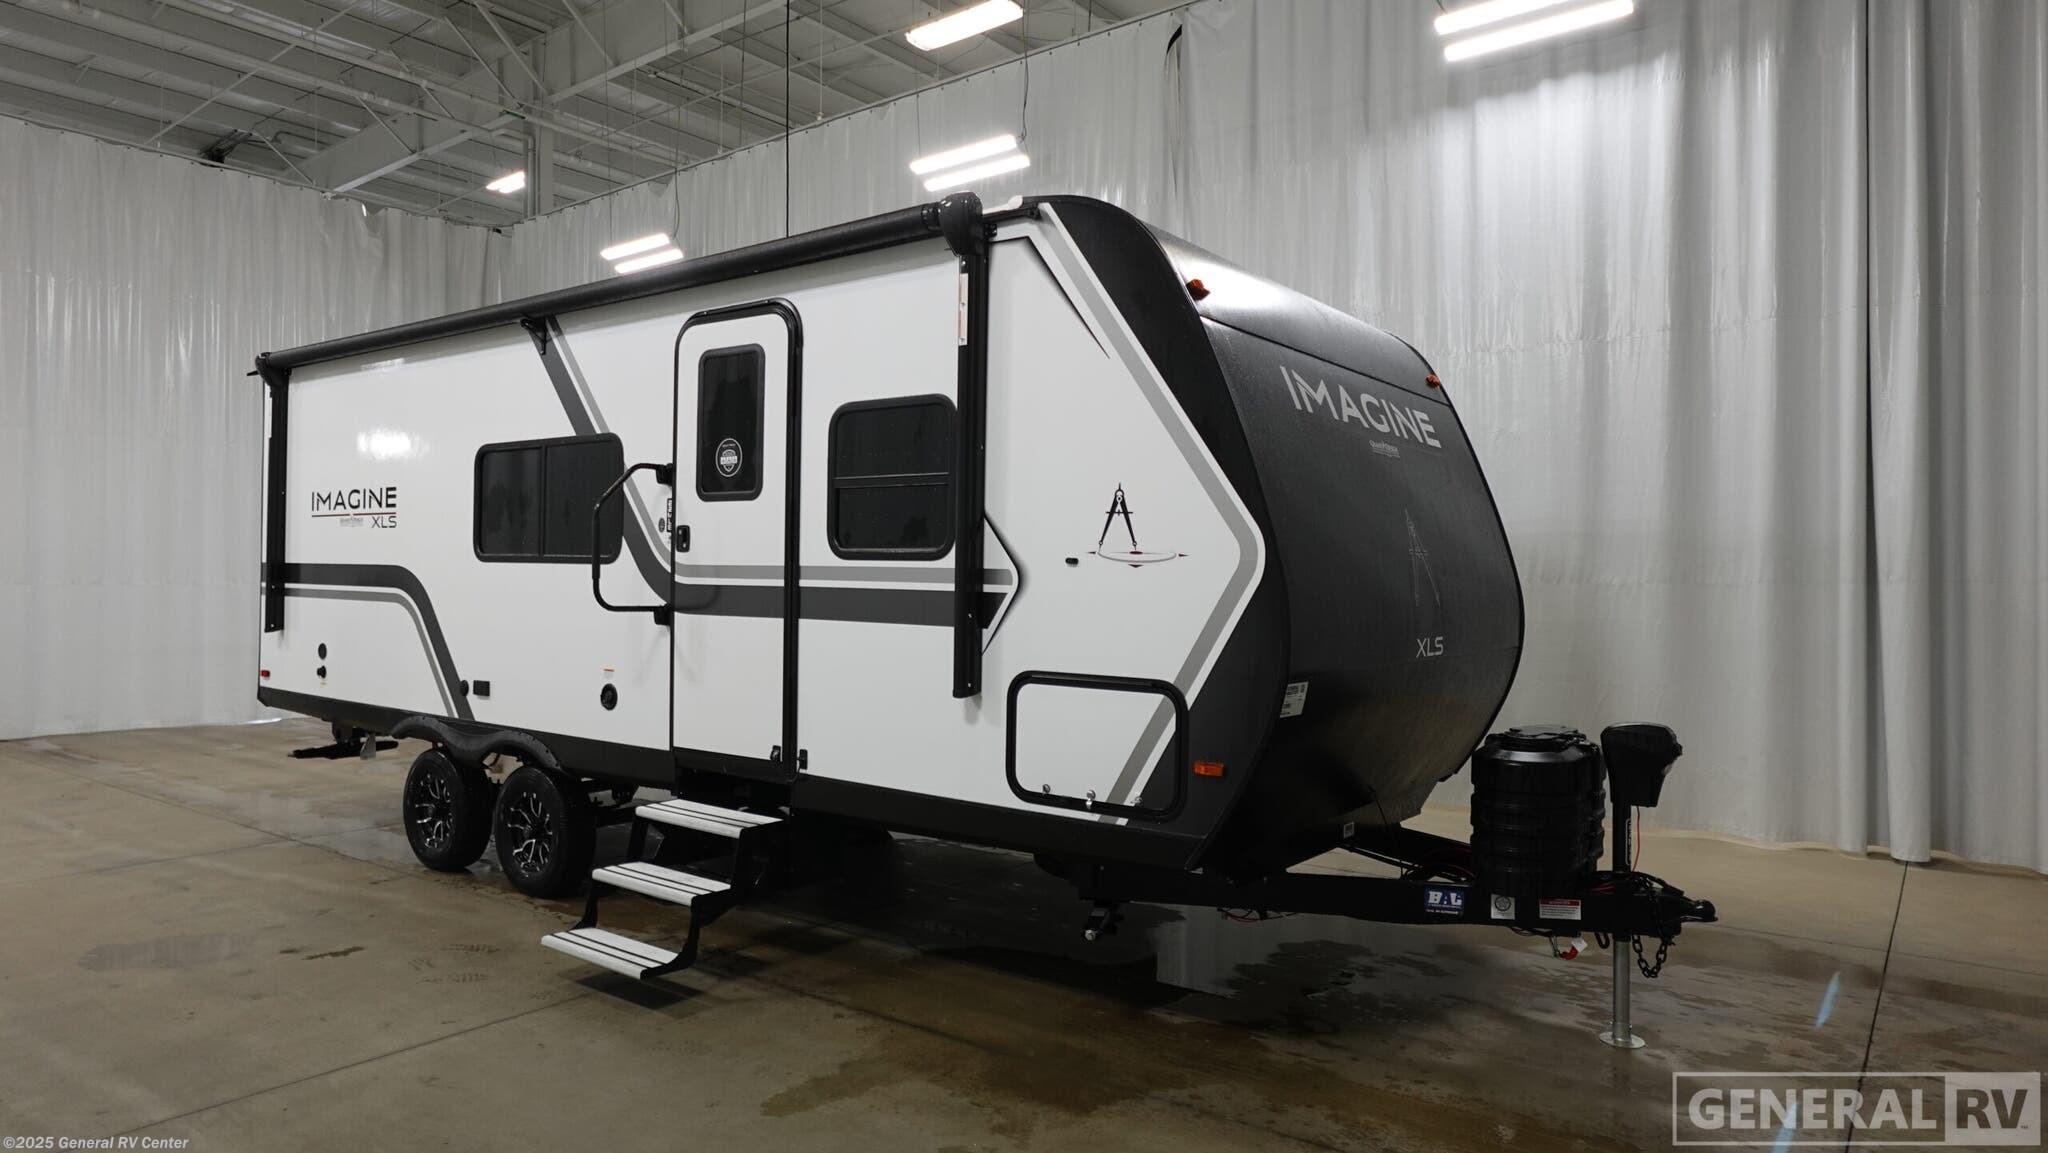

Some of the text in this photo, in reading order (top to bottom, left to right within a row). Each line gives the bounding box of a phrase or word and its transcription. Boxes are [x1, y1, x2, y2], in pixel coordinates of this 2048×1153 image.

[1279, 365, 1442, 449] IMAGINE
[311, 486, 397, 512] IMAGINE
[371, 515, 398, 529] XLS
[1415, 636, 1444, 659] XLS
